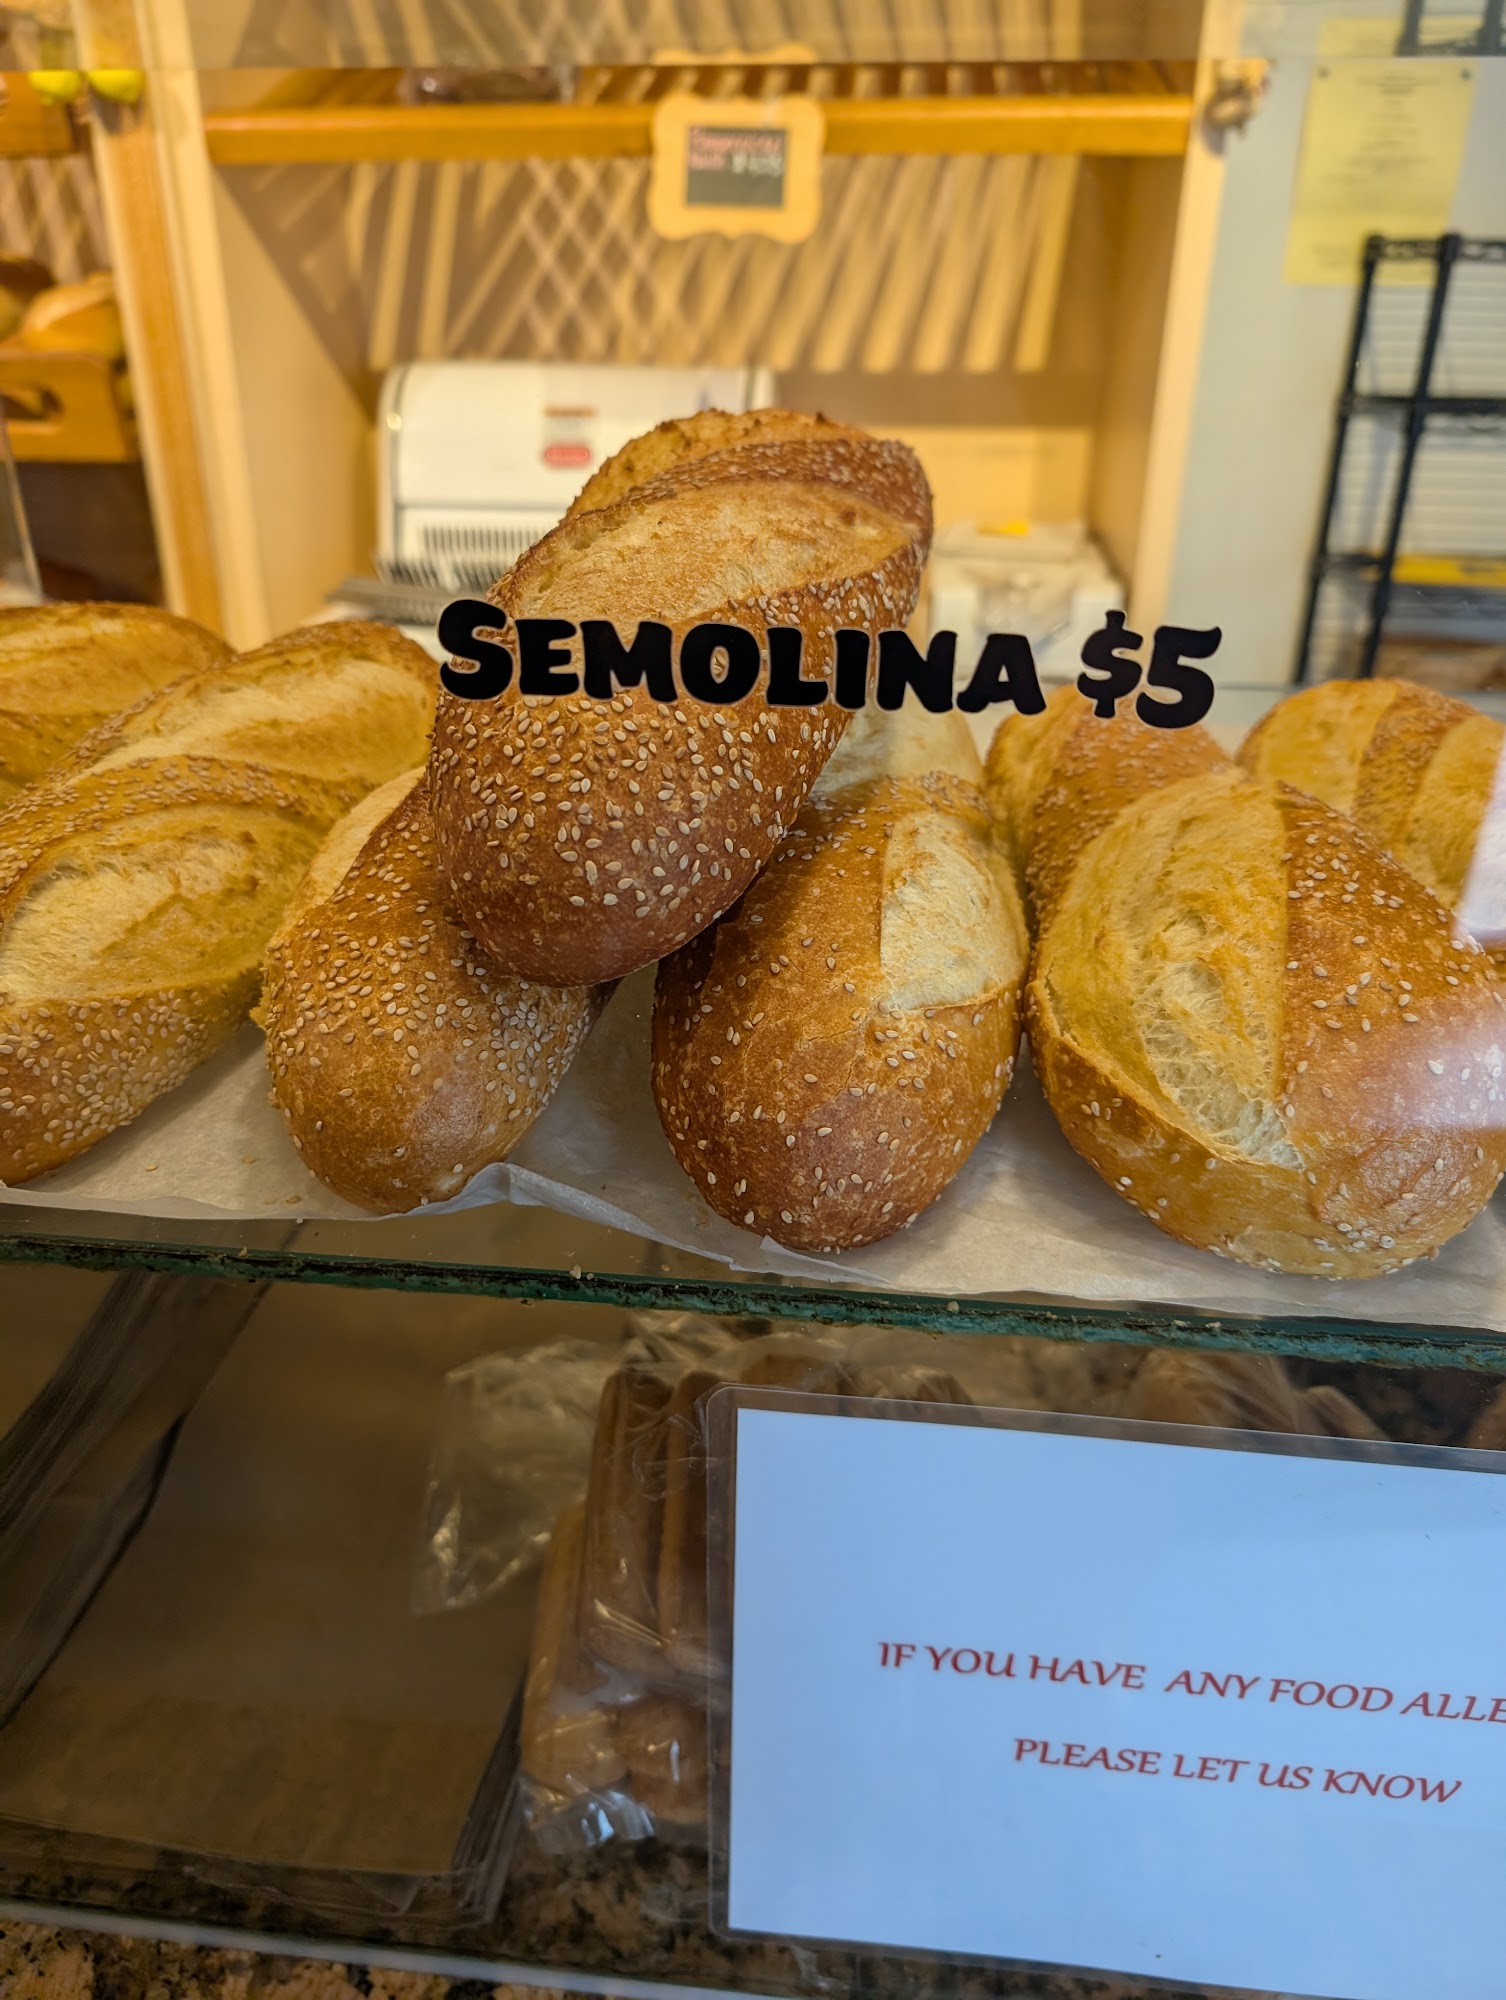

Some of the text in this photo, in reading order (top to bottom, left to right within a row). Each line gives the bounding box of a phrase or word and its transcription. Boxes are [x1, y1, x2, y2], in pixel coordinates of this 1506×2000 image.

[438, 599, 1222, 729] SEMOLINA $5
[879, 1642, 917, 1669] IF
[925, 1645, 1015, 1679] YOU
[1028, 1654, 1147, 1690] HAVE
[1165, 1670, 1260, 1700] ANY
[1269, 1679, 1394, 1712] FOOD
[1014, 1738, 1462, 1804] PLEASE LET US KNOW
